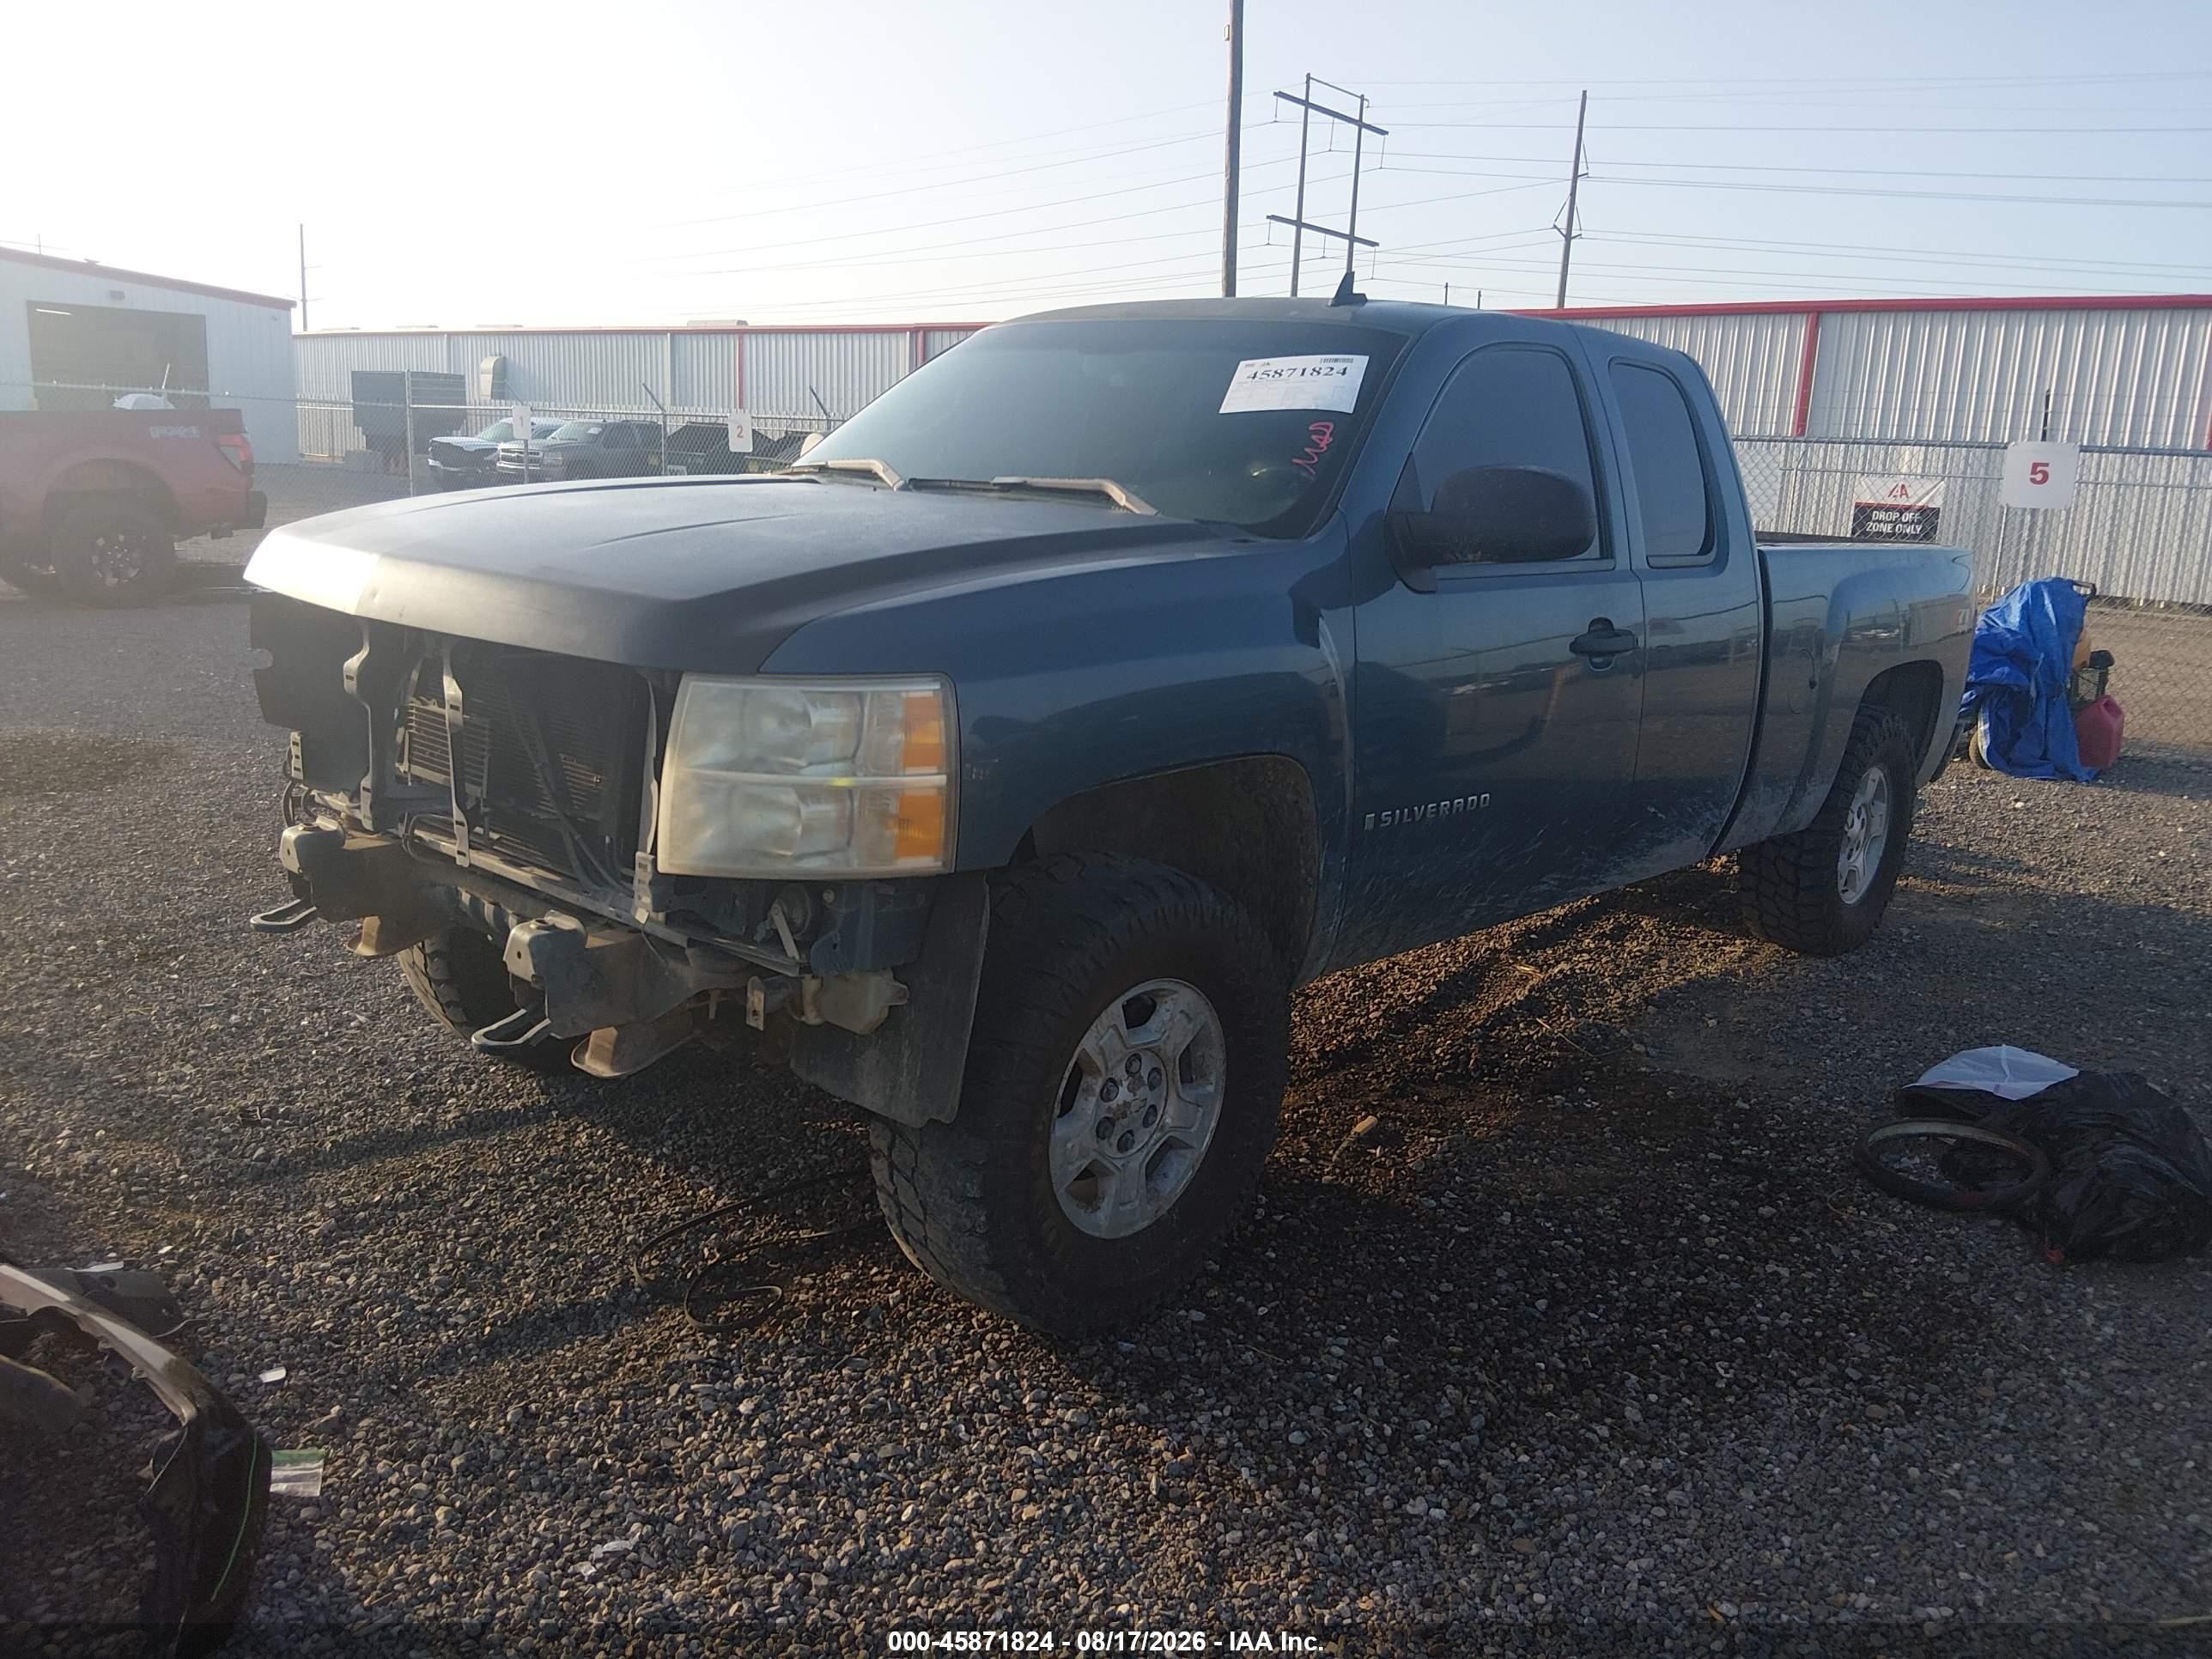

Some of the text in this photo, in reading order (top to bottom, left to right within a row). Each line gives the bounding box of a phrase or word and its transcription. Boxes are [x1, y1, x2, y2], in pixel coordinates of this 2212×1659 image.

[1247, 367, 1348, 380] 45871824
[736, 425, 744, 439] 2
[2029, 462, 2050, 485] 5
[1872, 510, 1922, 523] DROP OFF
[1866, 521, 1923, 534] ZONE ONLY
[1380, 793, 1491, 828] SILVERADO
